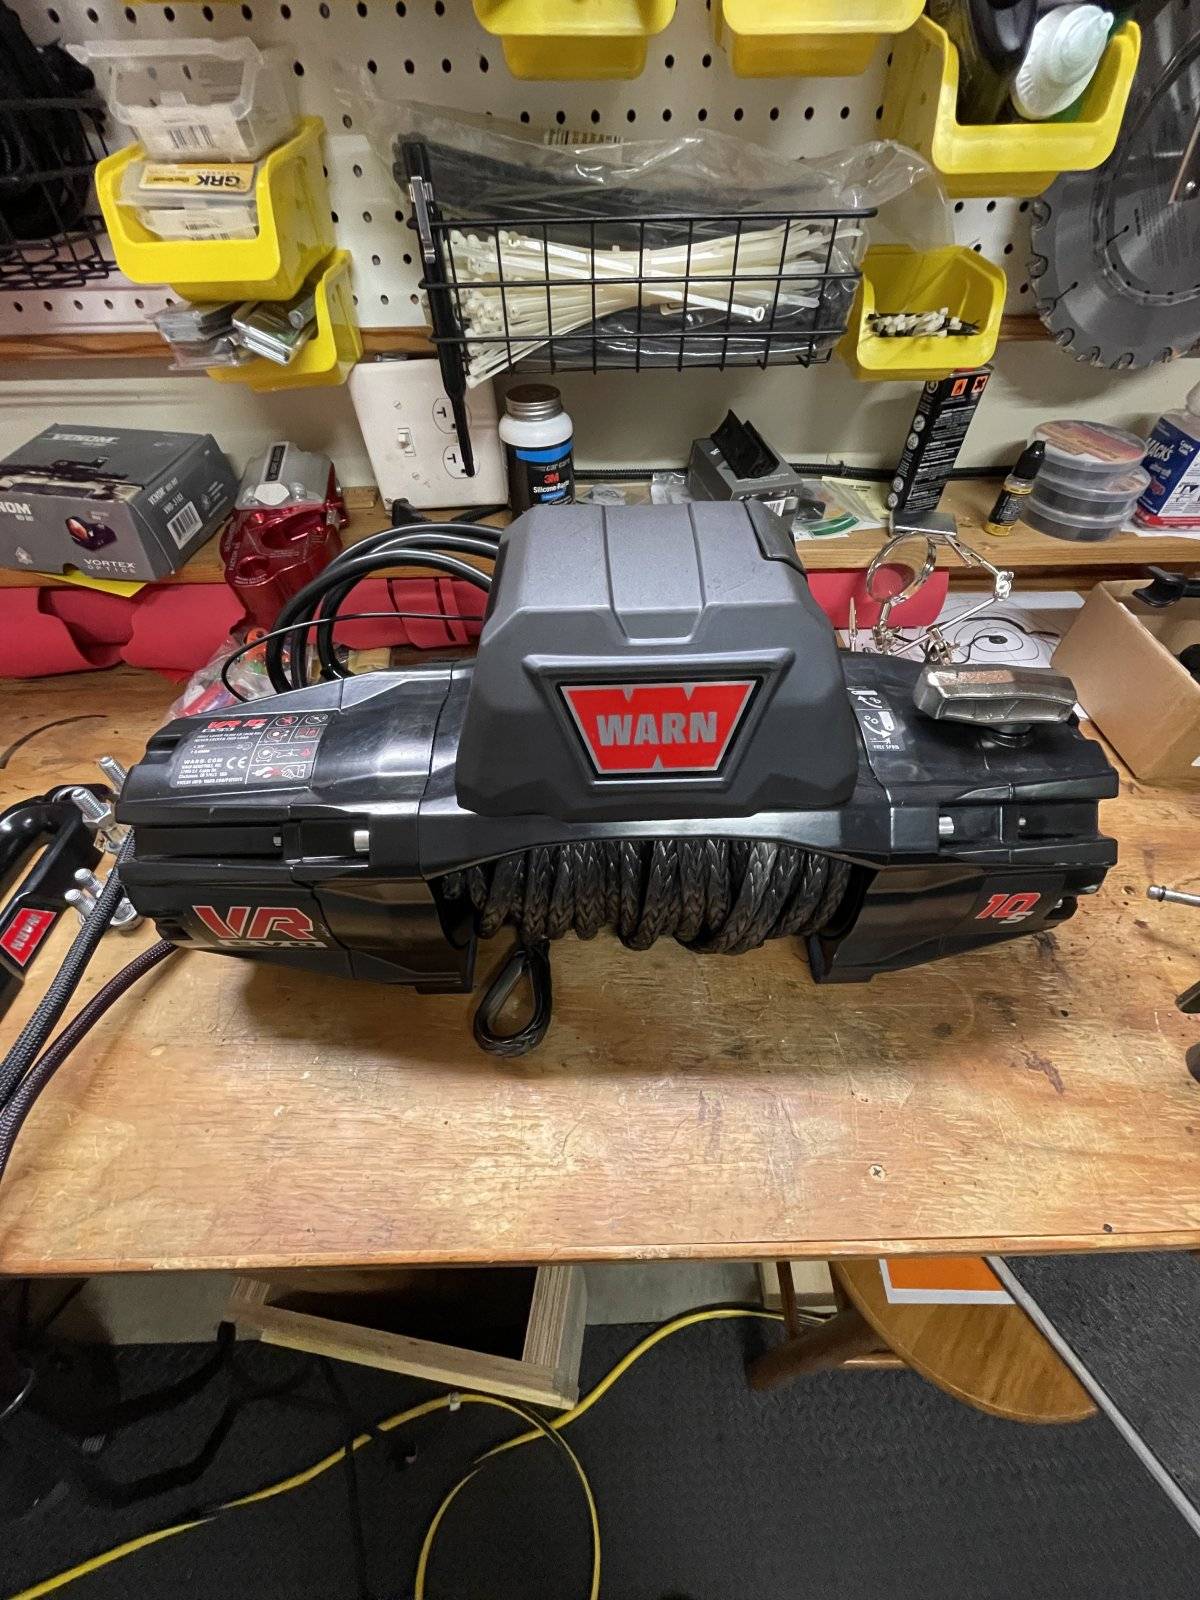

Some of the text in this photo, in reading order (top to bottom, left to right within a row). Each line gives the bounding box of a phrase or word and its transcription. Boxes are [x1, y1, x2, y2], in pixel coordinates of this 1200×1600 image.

[196, 174, 241, 187] GRK
[543, 472, 560, 484] 3M
[83, 558, 137, 569] VORTEX
[596, 711, 718, 746] WARN
[10, 913, 43, 951] WARN
[191, 905, 317, 940] VR
